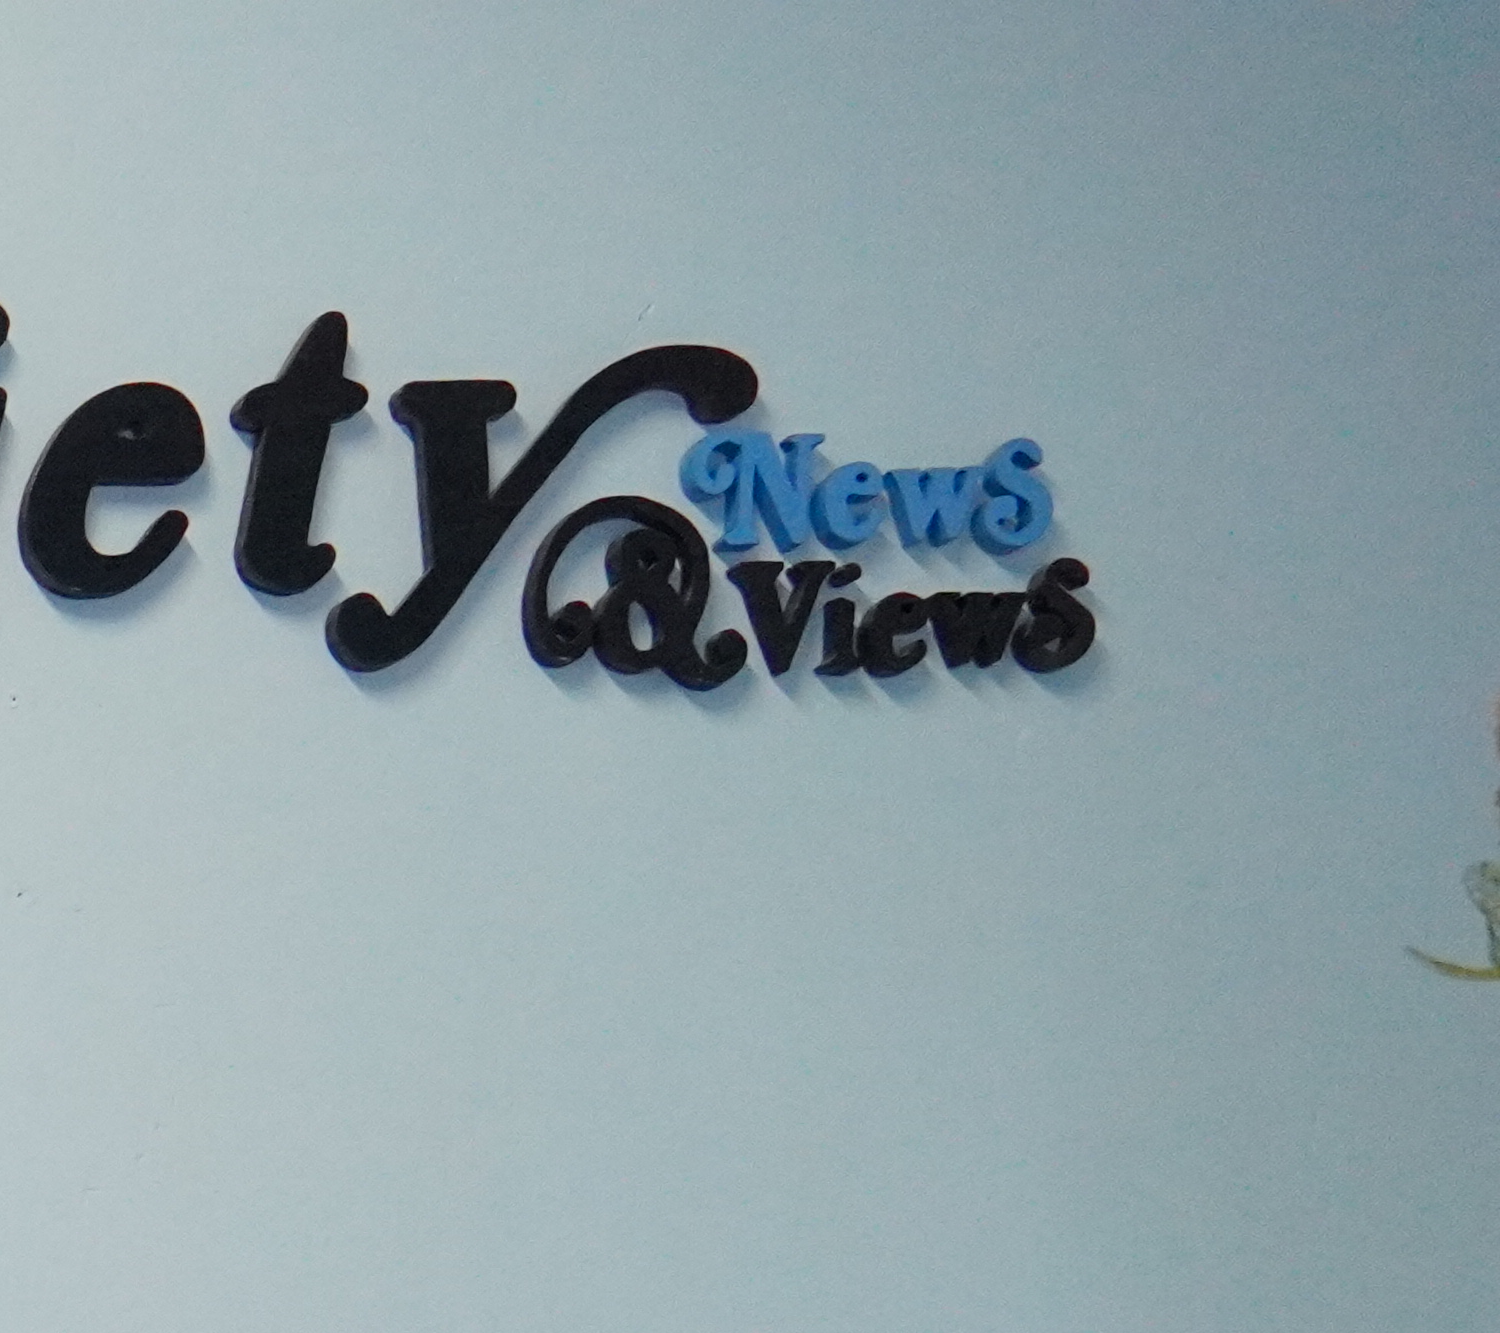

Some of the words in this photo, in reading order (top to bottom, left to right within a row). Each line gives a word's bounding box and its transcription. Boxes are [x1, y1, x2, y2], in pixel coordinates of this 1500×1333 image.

[680, 430, 1055, 556] News
[523, 496, 748, 692] &
[726, 557, 1097, 678] Views
